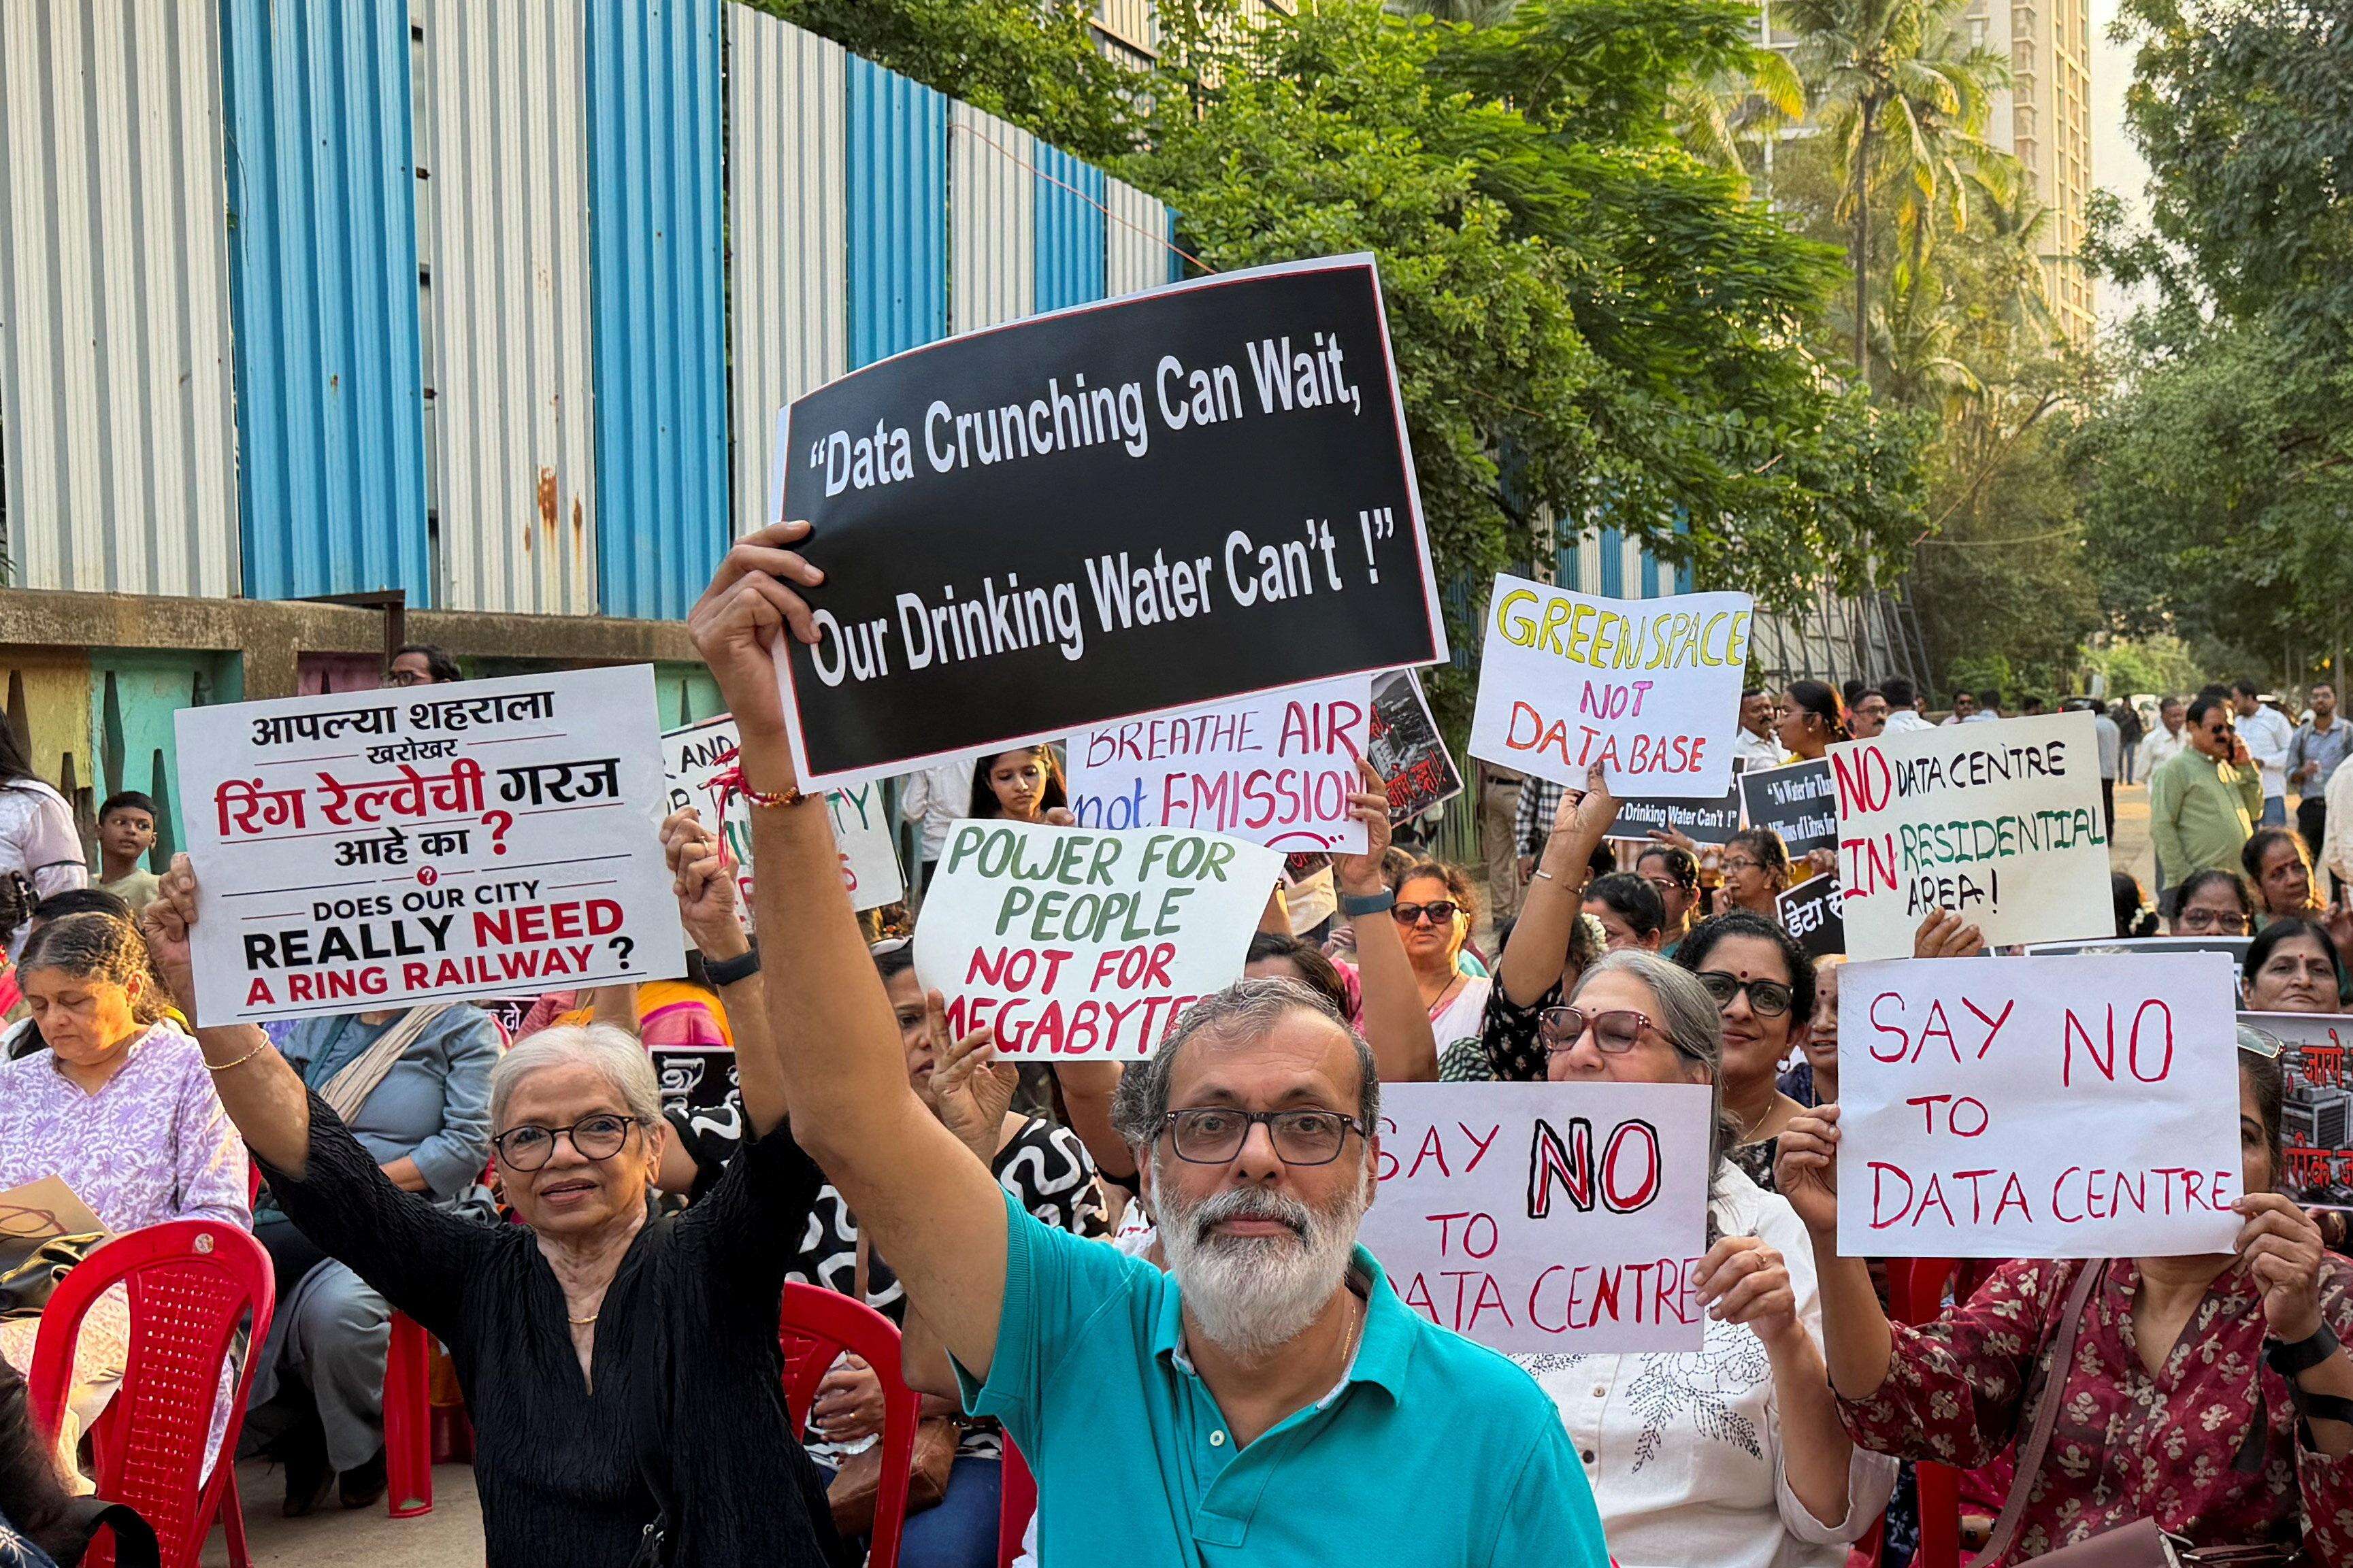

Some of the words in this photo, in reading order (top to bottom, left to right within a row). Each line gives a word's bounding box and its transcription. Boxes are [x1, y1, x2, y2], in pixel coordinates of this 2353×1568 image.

[810, 417, 913, 498] “Data
[925, 373, 1149, 473] Crunching
[1156, 354, 1244, 431] Can
[1246, 331, 1361, 416] Wait,
[810, 607, 889, 687] Our
[895, 571, 1084, 671] Drinking
[1085, 548, 1213, 633] Water
[1224, 518, 1343, 607] Can’t
[252, 705, 397, 746] आपल्या
[410, 691, 555, 735] शहराला
[1579, 680, 1653, 720] NOT
[366, 737, 458, 765] खरोखर
[1087, 711, 1262, 769] BREATHE
[1279, 701, 1362, 759] AIR
[214, 777, 306, 836] रिंग
[317, 758, 486, 828] रेल्वेची
[497, 758, 620, 804] गरज
[1072, 777, 1150, 830] not
[1832, 746, 1892, 820] NO
[1896, 756, 1946, 797] DATA
[1949, 740, 2065, 788] CENTRE
[1626, 802, 1666, 828] Drinking
[1668, 805, 1696, 826] Water
[335, 827, 408, 867] आहे
[419, 829, 469, 858] का
[948, 826, 1122, 886] POWER
[1138, 833, 1236, 883] FOR
[1841, 833, 1897, 901] IN
[1900, 805, 2105, 875] RESIDENTIAL
[313, 896, 393, 922] DOES
[402, 888, 465, 912] OUR
[475, 881, 540, 905] CITY
[996, 886, 1196, 944] PEOPLE
[243, 915, 455, 971] REALLY
[473, 898, 624, 948] NEED
[246, 978, 276, 1006] A
[288, 966, 389, 1003] RING
[404, 944, 595, 990] RAILWAY
[964, 946, 1074, 993] NOT
[1090, 942, 1176, 993] FOR
[1869, 992, 2015, 1064] SAY
[2063, 999, 2173, 1088] NO
[1906, 1095, 1989, 1137] TO
[1528, 1117, 1661, 1218] NO
[1867, 1161, 2033, 1229] DATA
[2052, 1166, 2233, 1222] CENTRE
[1426, 1212, 1498, 1258] TO
[1386, 1271, 1513, 1331] ATA
[1529, 1257, 1700, 1333] CENTRE
